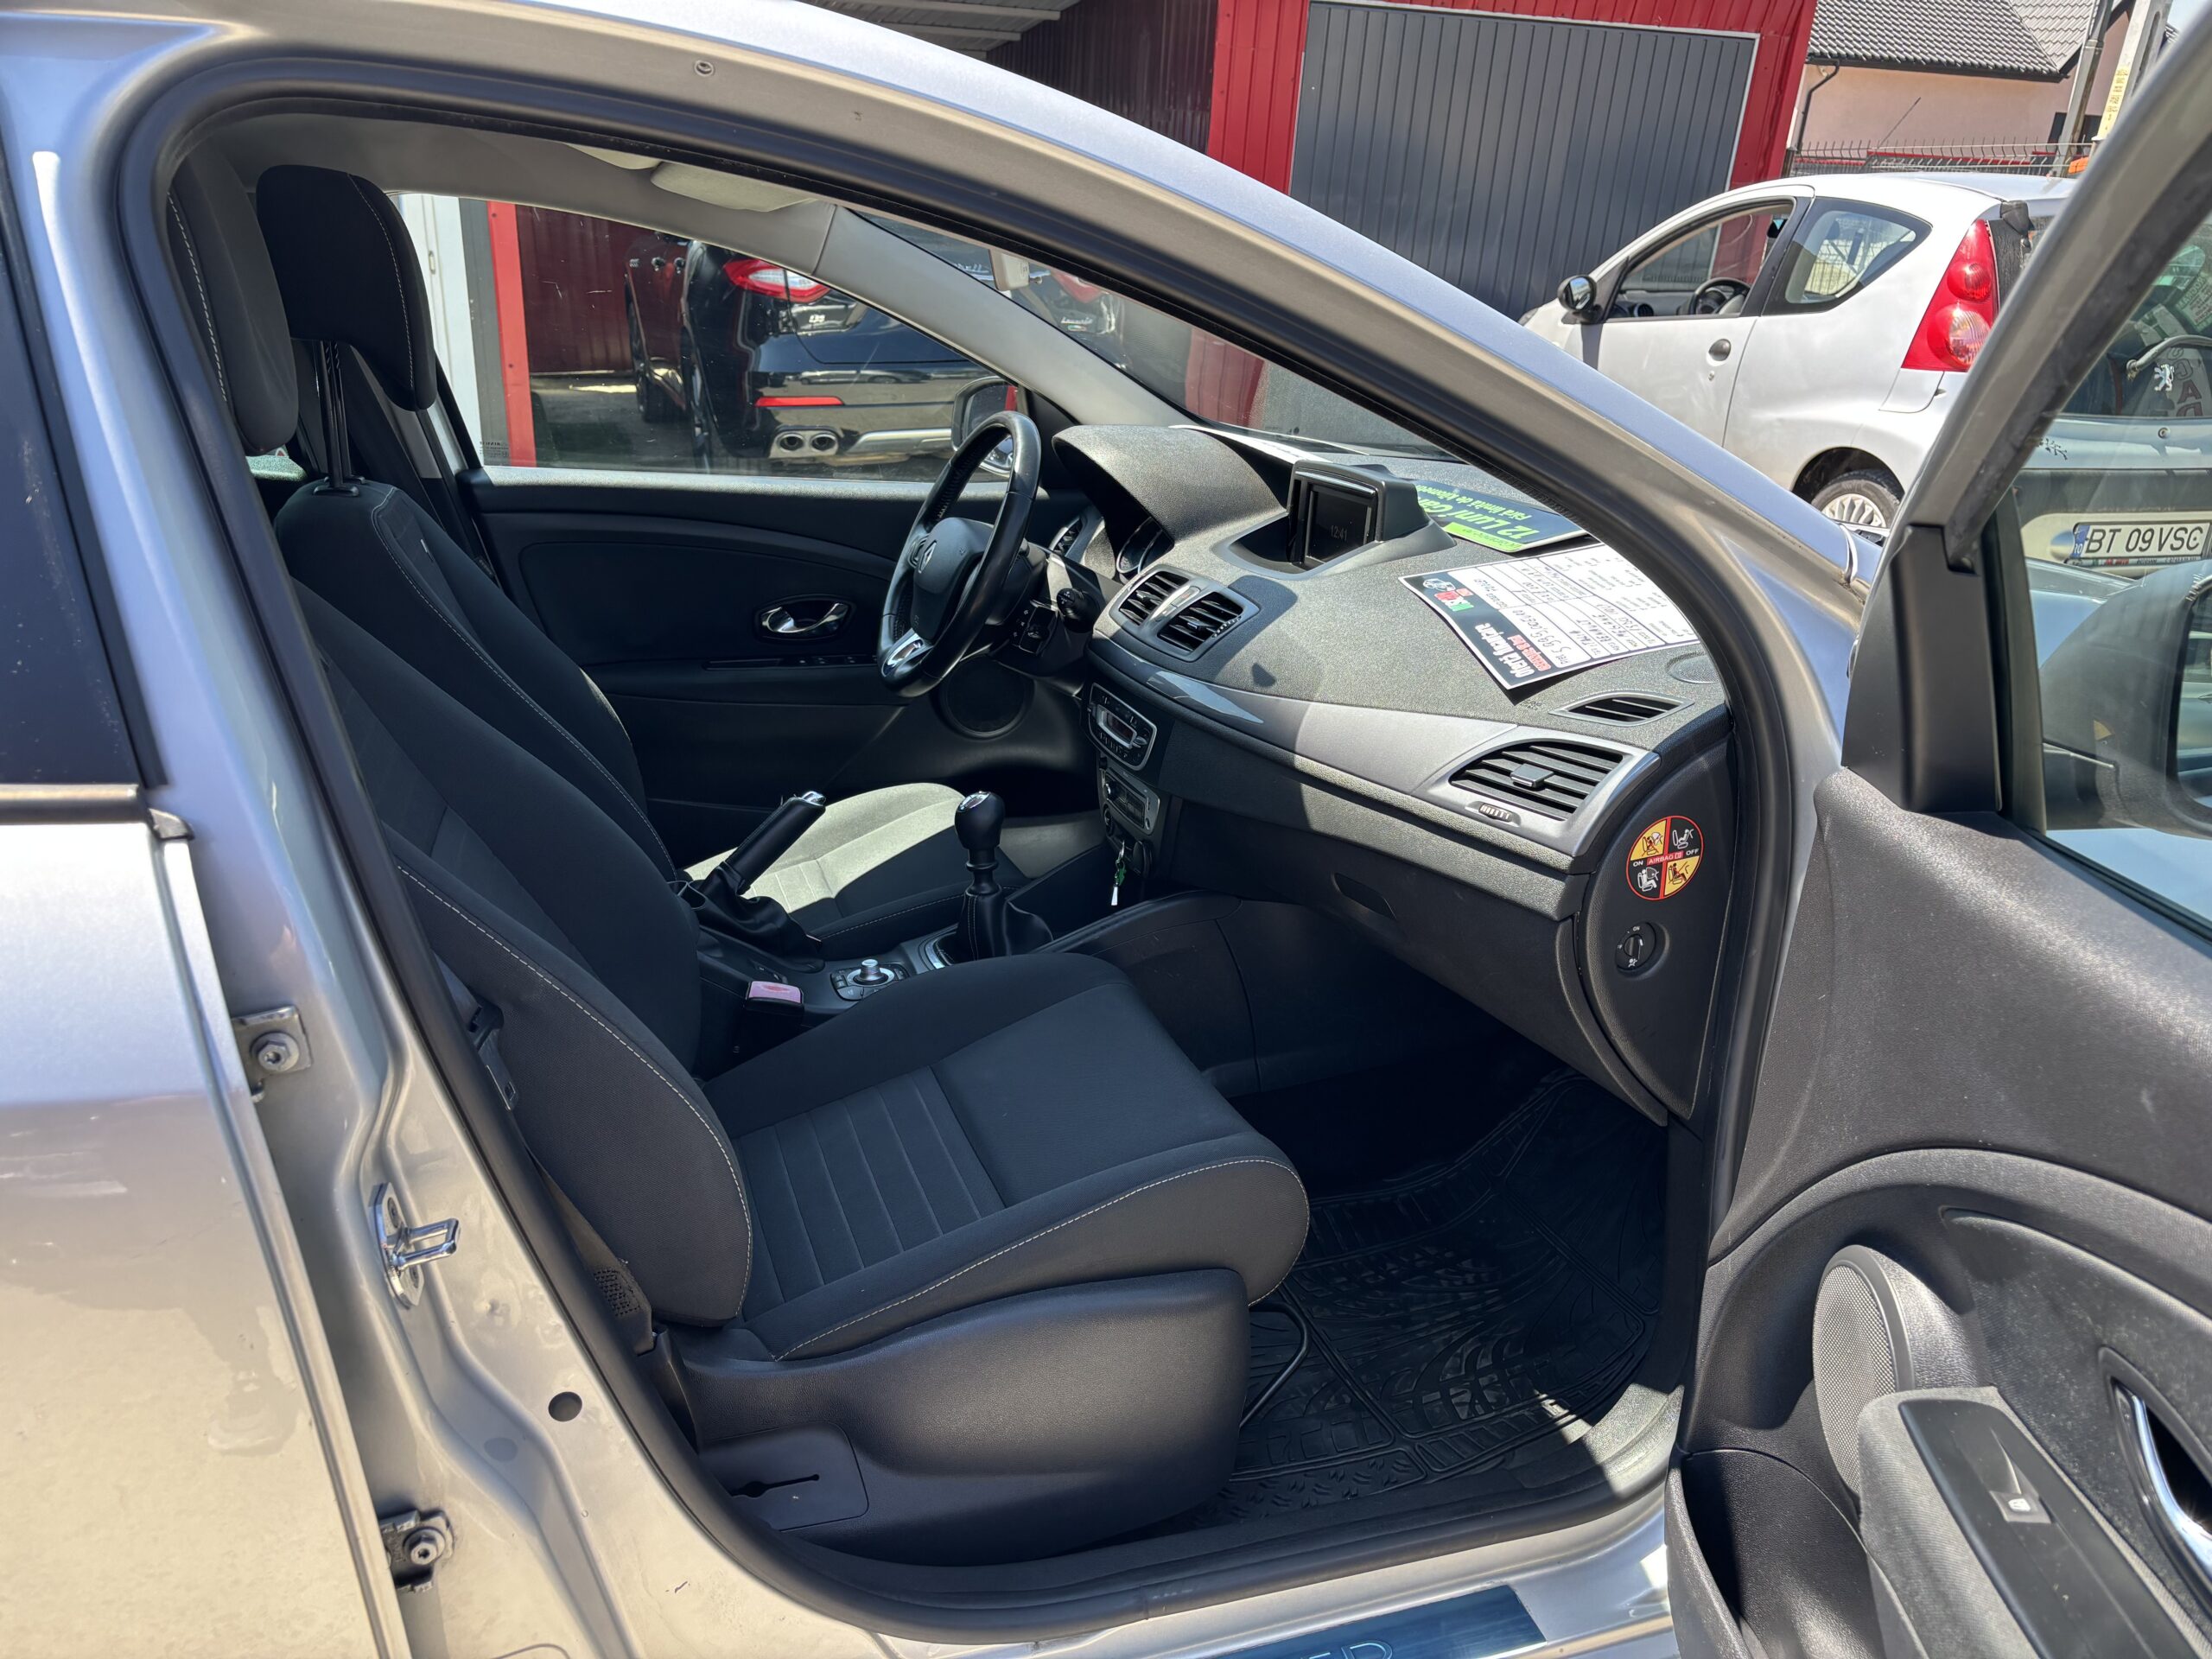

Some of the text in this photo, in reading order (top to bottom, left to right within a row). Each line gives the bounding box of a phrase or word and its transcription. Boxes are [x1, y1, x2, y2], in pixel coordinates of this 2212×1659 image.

[1438, 509, 1511, 530] Luni
[1331, 524, 1348, 542] 12:41
[1497, 525, 1540, 540] 12
[2085, 528, 2122, 554] BT
[2125, 527, 2155, 553] 09
[1648, 855, 1674, 865] AIRBAG
[1686, 848, 1700, 856] OFF
